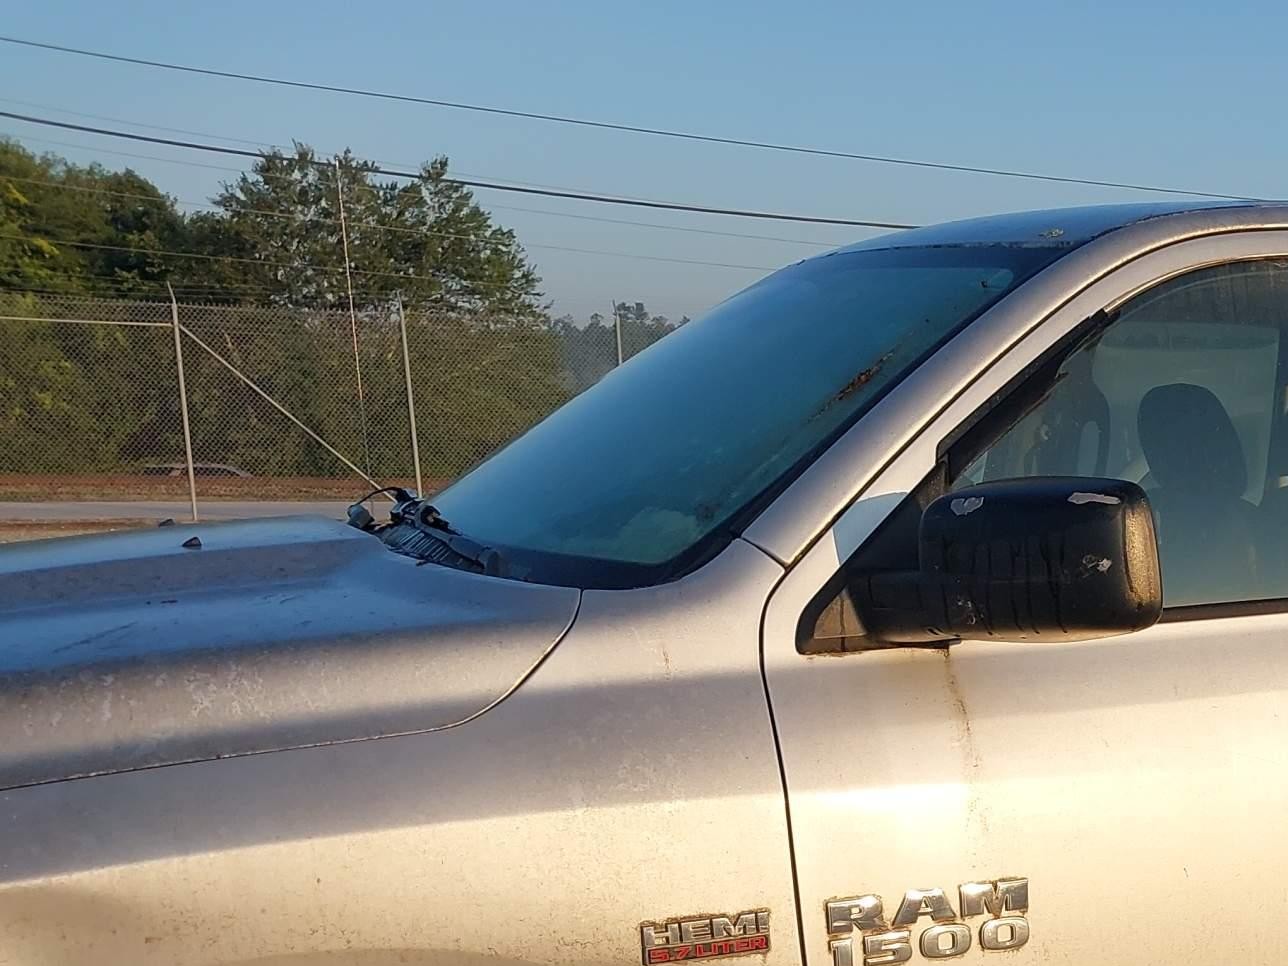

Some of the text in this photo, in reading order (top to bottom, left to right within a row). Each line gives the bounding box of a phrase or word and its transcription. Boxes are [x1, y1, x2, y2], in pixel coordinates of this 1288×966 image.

[828, 880, 1028, 932] RAM
[641, 912, 769, 946] HEMI
[649, 936, 767, 963] 5.7 LITER
